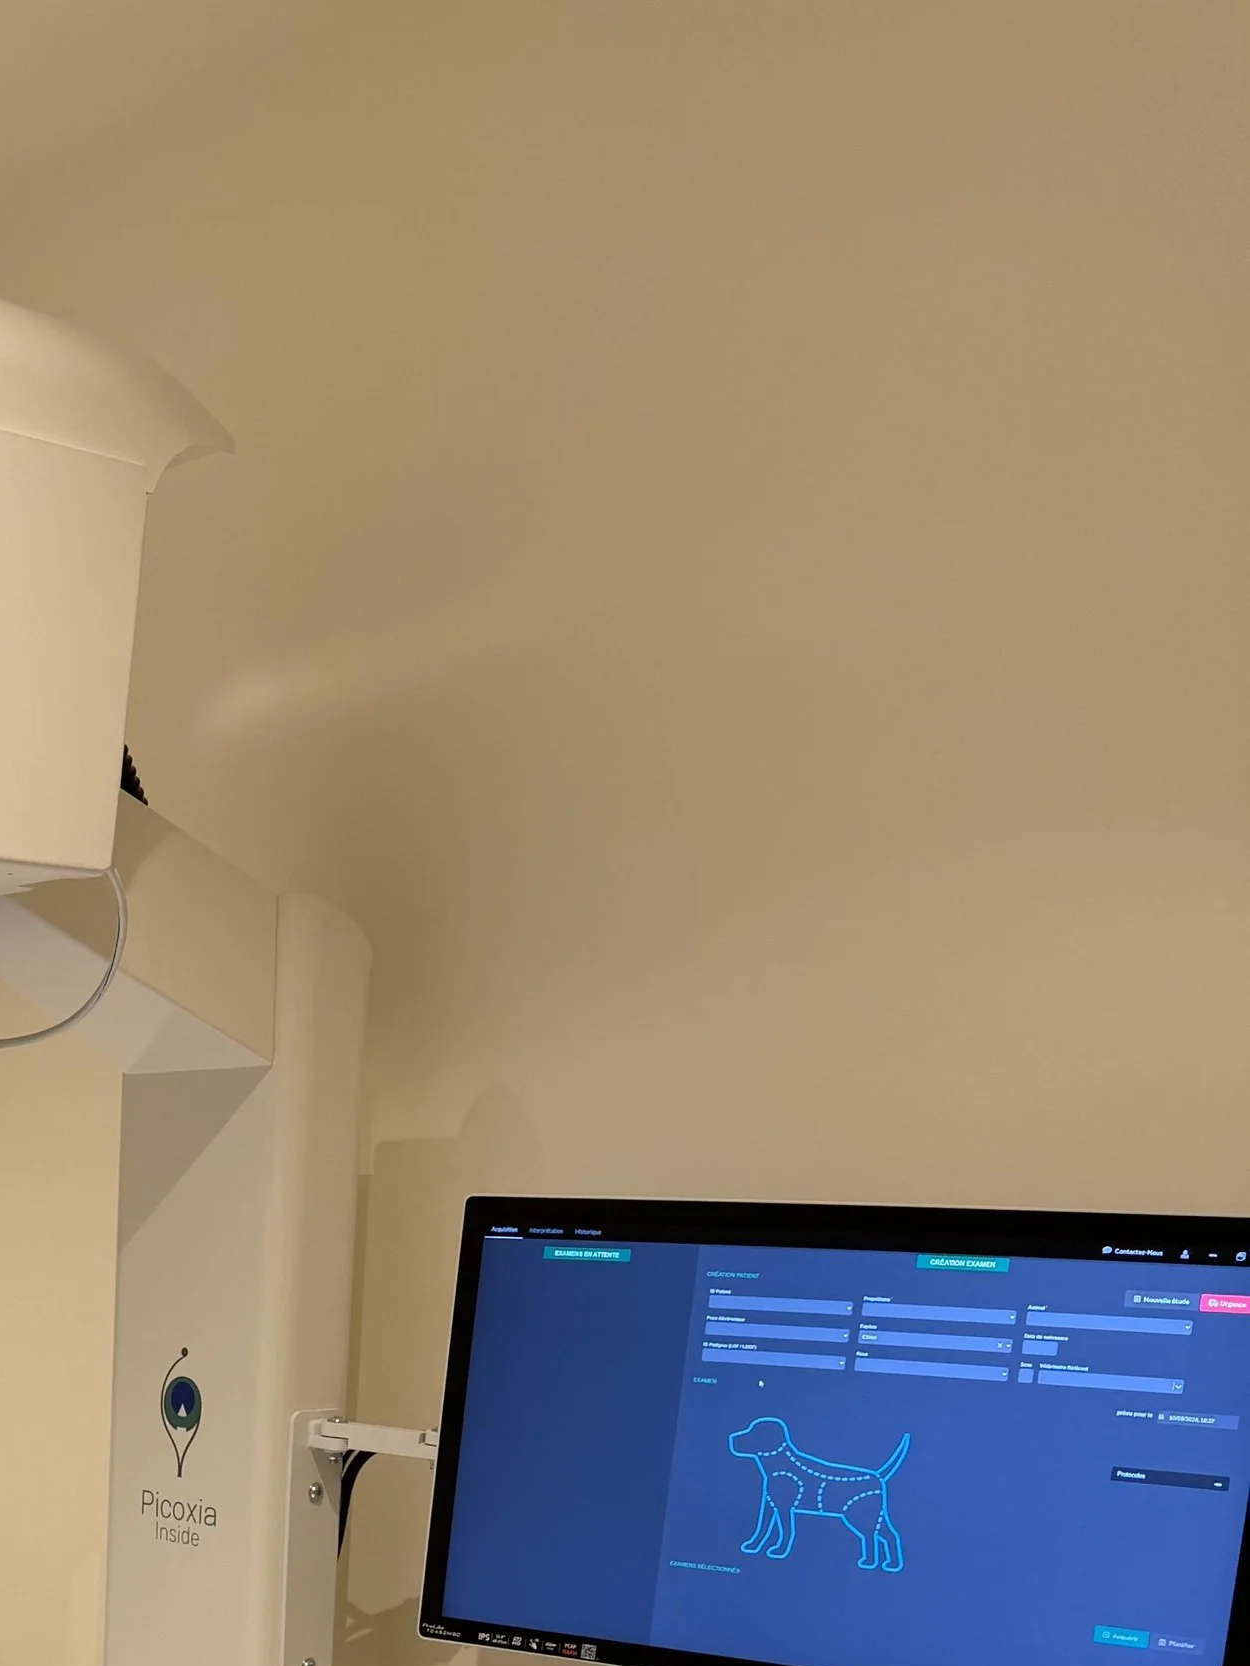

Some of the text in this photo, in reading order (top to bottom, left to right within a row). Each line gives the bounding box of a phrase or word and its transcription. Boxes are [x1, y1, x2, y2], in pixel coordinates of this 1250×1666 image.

[966, 1260, 996, 1268] EXAMEN
[141, 1490, 217, 1527] Picoxia
[155, 1521, 200, 1547] Inside
[478, 1632, 490, 1641] IPS
